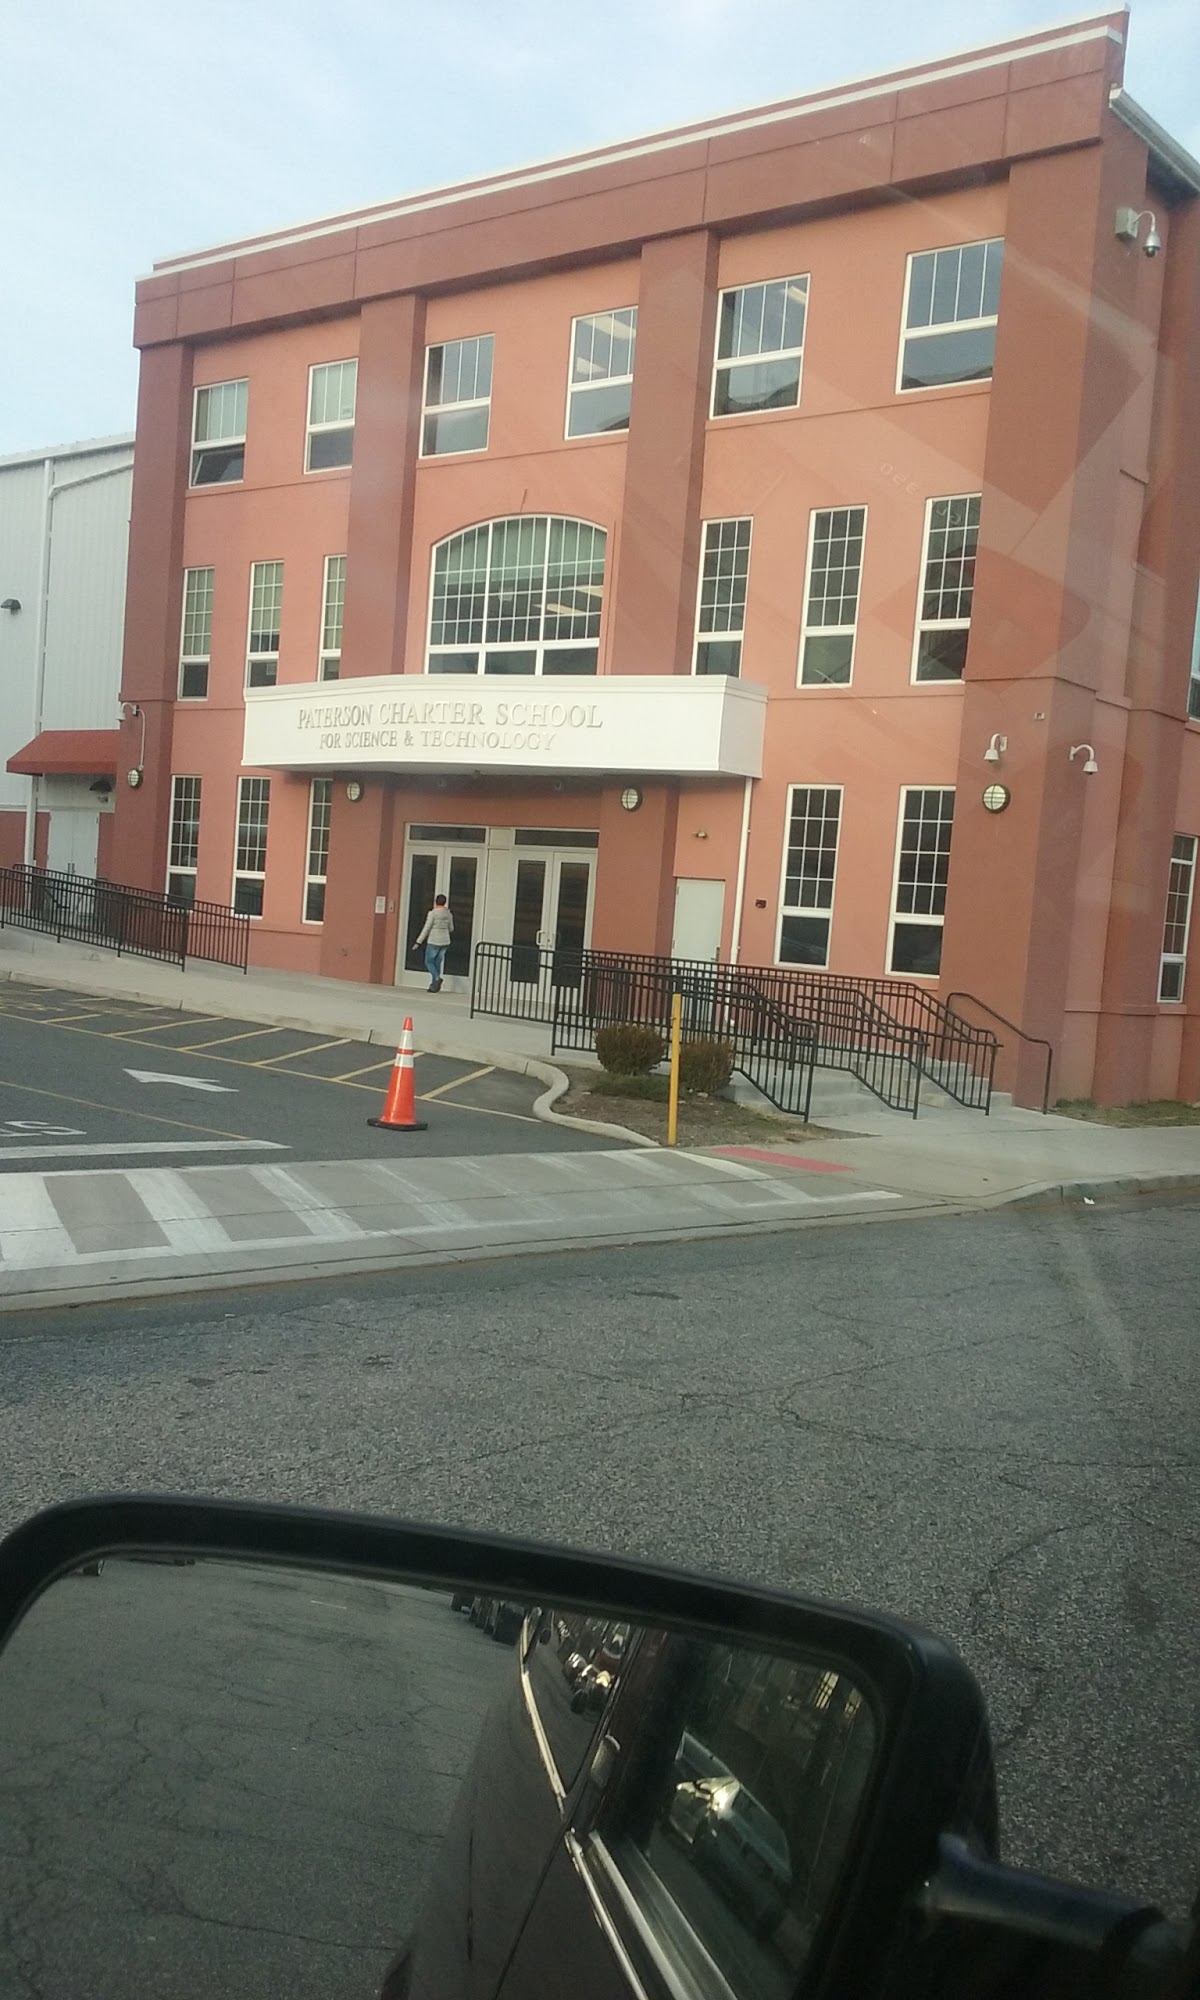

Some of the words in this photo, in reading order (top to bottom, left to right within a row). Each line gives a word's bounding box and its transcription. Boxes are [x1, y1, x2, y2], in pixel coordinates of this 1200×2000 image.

[297, 703, 374, 730] PATERSON
[378, 701, 486, 726] CHARTER
[494, 702, 604, 729] SCHOOL
[319, 732, 342, 750] FOR
[344, 730, 398, 749] SCIENCE
[403, 729, 414, 747] &
[420, 730, 557, 751] TECHNOLOGY
